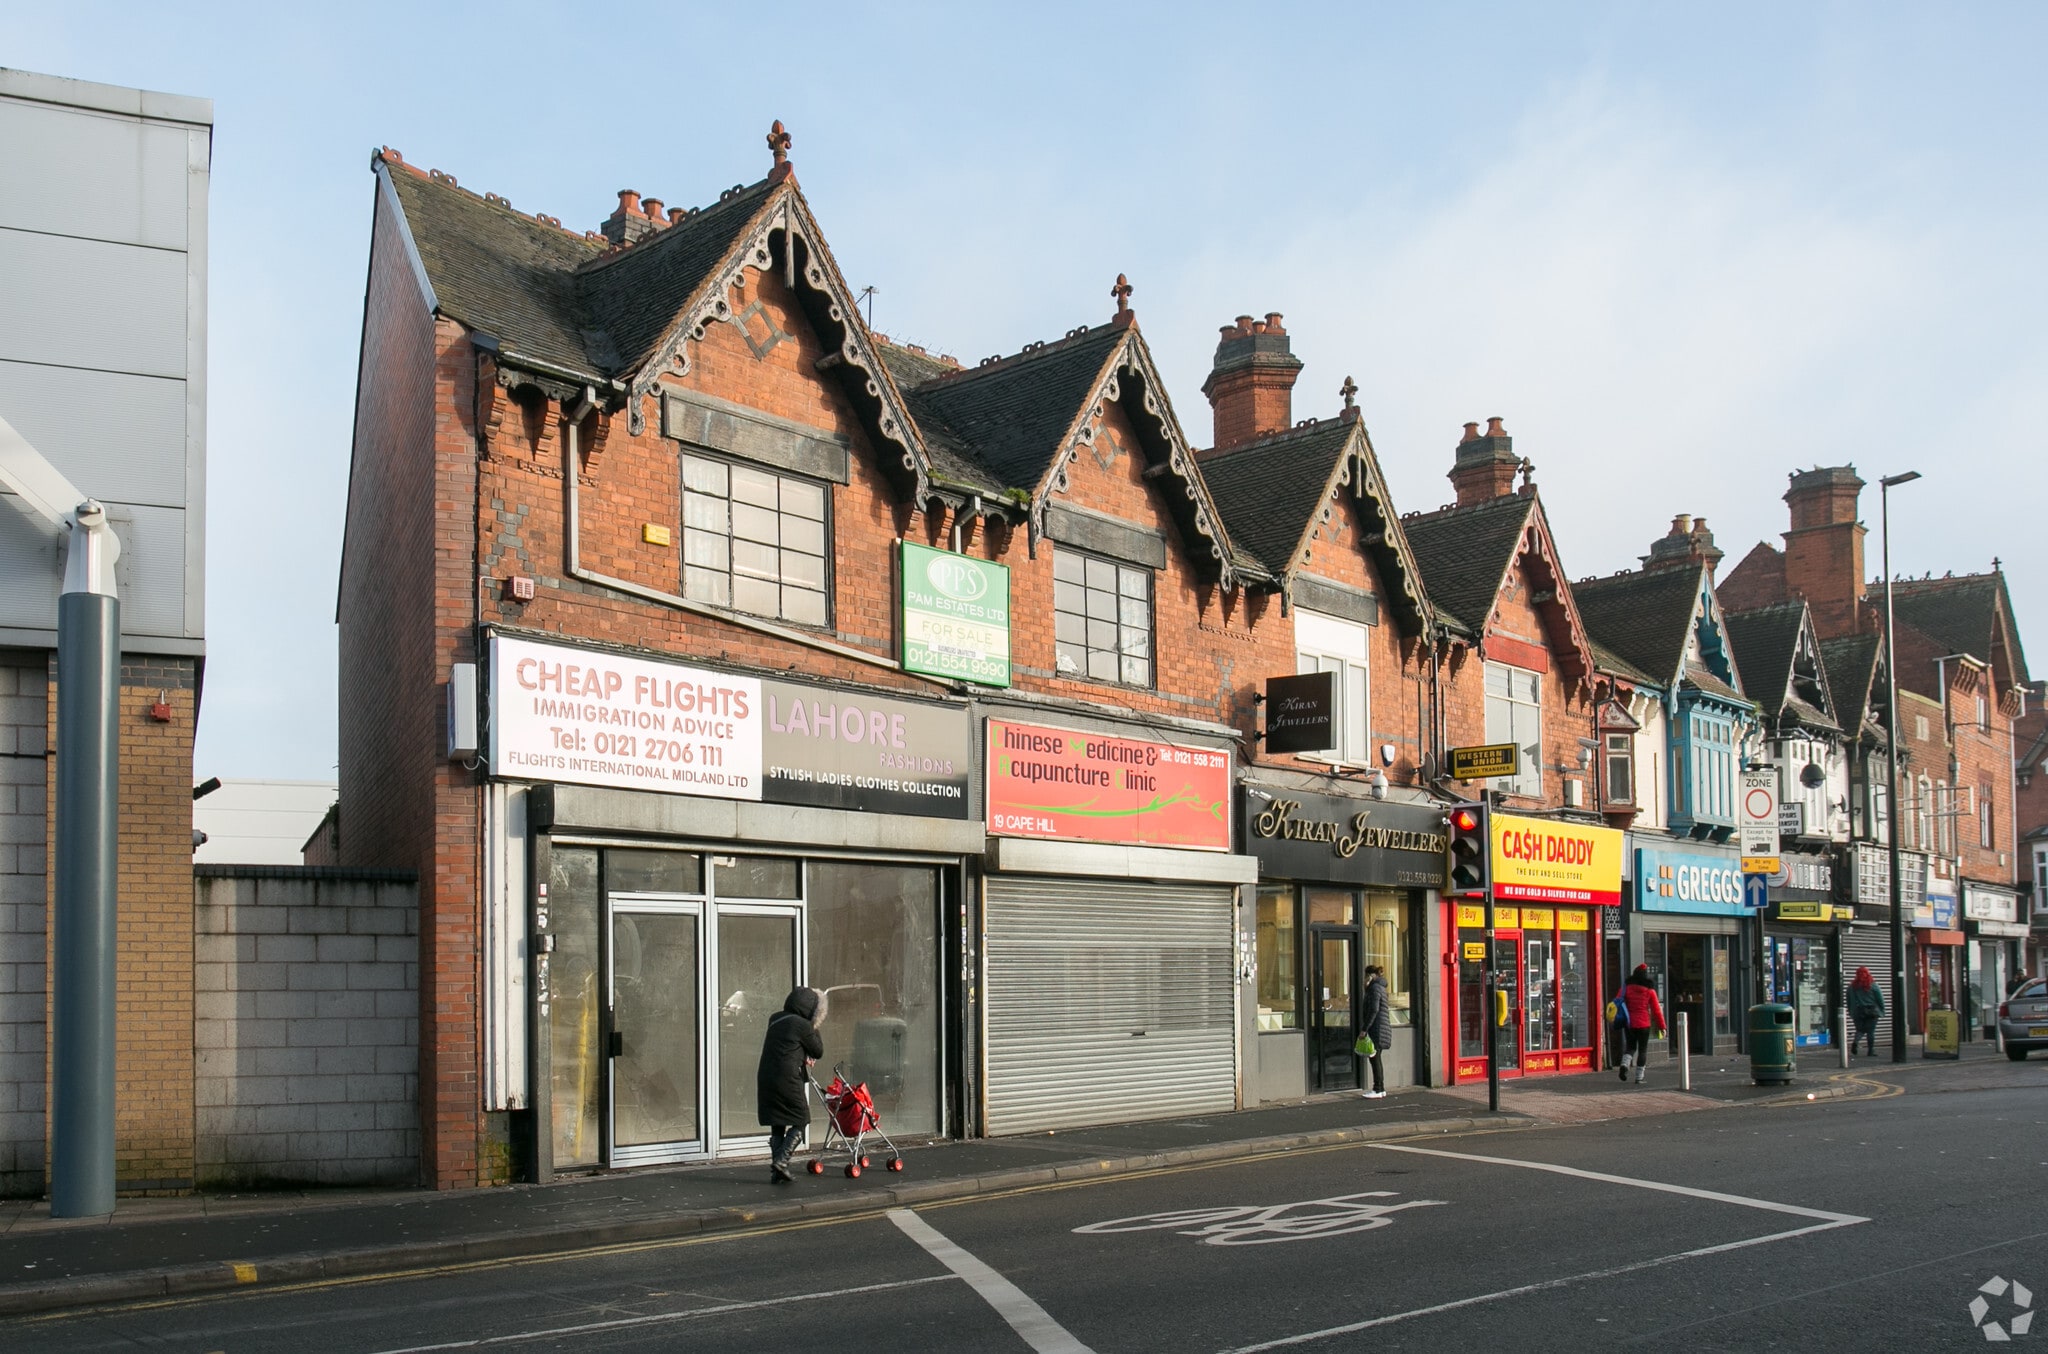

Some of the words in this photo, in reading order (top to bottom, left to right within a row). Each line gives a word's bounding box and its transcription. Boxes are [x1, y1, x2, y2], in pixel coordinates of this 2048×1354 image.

[939, 562, 977, 595] PPS
[908, 591, 933, 607] PAM
[935, 597, 984, 618] ESTATES
[986, 608, 1006, 622] LTD
[922, 620, 953, 639] FOR
[956, 627, 993, 646] SALE
[908, 647, 939, 666] 0121
[941, 655, 969, 672] 554
[971, 660, 1006, 678] 9990
[516, 657, 623, 700] CHEAP
[634, 675, 750, 720] FLIGHTS
[533, 697, 666, 731] IMMIGRATION
[672, 716, 734, 740] ADVICE
[769, 694, 907, 749] LAHORE
[549, 726, 587, 752] Tel:
[593, 731, 637, 757] 0121
[644, 738, 694, 764] 2706
[699, 744, 723, 767] 111
[992, 725, 1063, 755] Chinese
[1068, 737, 1144, 765] Medicine
[1146, 746, 1159, 767] &
[1174, 751, 1191, 765] 0121
[1193, 753, 1208, 767] 558
[1209, 755, 1225, 769] 2111
[1457, 750, 1503, 761] WESTERN
[1472, 757, 1503, 766] UNION
[508, 751, 566, 769] FLIGHTS
[569, 757, 669, 780] INTERNATIONAL
[672, 768, 725, 786] MIDLAND
[728, 774, 749, 788] LTD
[879, 752, 954, 776] FASHIONS
[997, 755, 1110, 788] Acupuncture
[1115, 768, 1157, 793] Clinic
[769, 766, 813, 782] STYLISH
[816, 771, 853, 787] LADIES
[855, 775, 900, 792] CLOTHES
[902, 780, 961, 799] COLLECTION
[1745, 778, 1772, 788] ZONE
[993, 814, 1005, 828] 19
[1006, 815, 1035, 832] CAPE
[1036, 818, 1057, 833] HILL
[1255, 798, 1339, 843] KIRAN
[1335, 810, 1447, 858] JEWELLERS
[1502, 828, 1543, 864] CA$H
[1546, 834, 1595, 866] DADDY
[1516, 867, 1527, 876] THE
[1528, 868, 1539, 877] BUY
[1541, 869, 1551, 878] AND
[1552, 870, 1565, 879] SELL
[1566, 872, 1583, 881] STORE
[1677, 864, 1743, 905] GREGGS
[1790, 863, 1832, 891] MOBILES
[1504, 886, 1514, 895] WE
[1514, 886, 1526, 896] BUY
[1526, 887, 1542, 897] GOLD
[1547, 889, 1566, 898] SILVER
[1566, 890, 1577, 899] FOR
[1577, 891, 1591, 900] CASH
